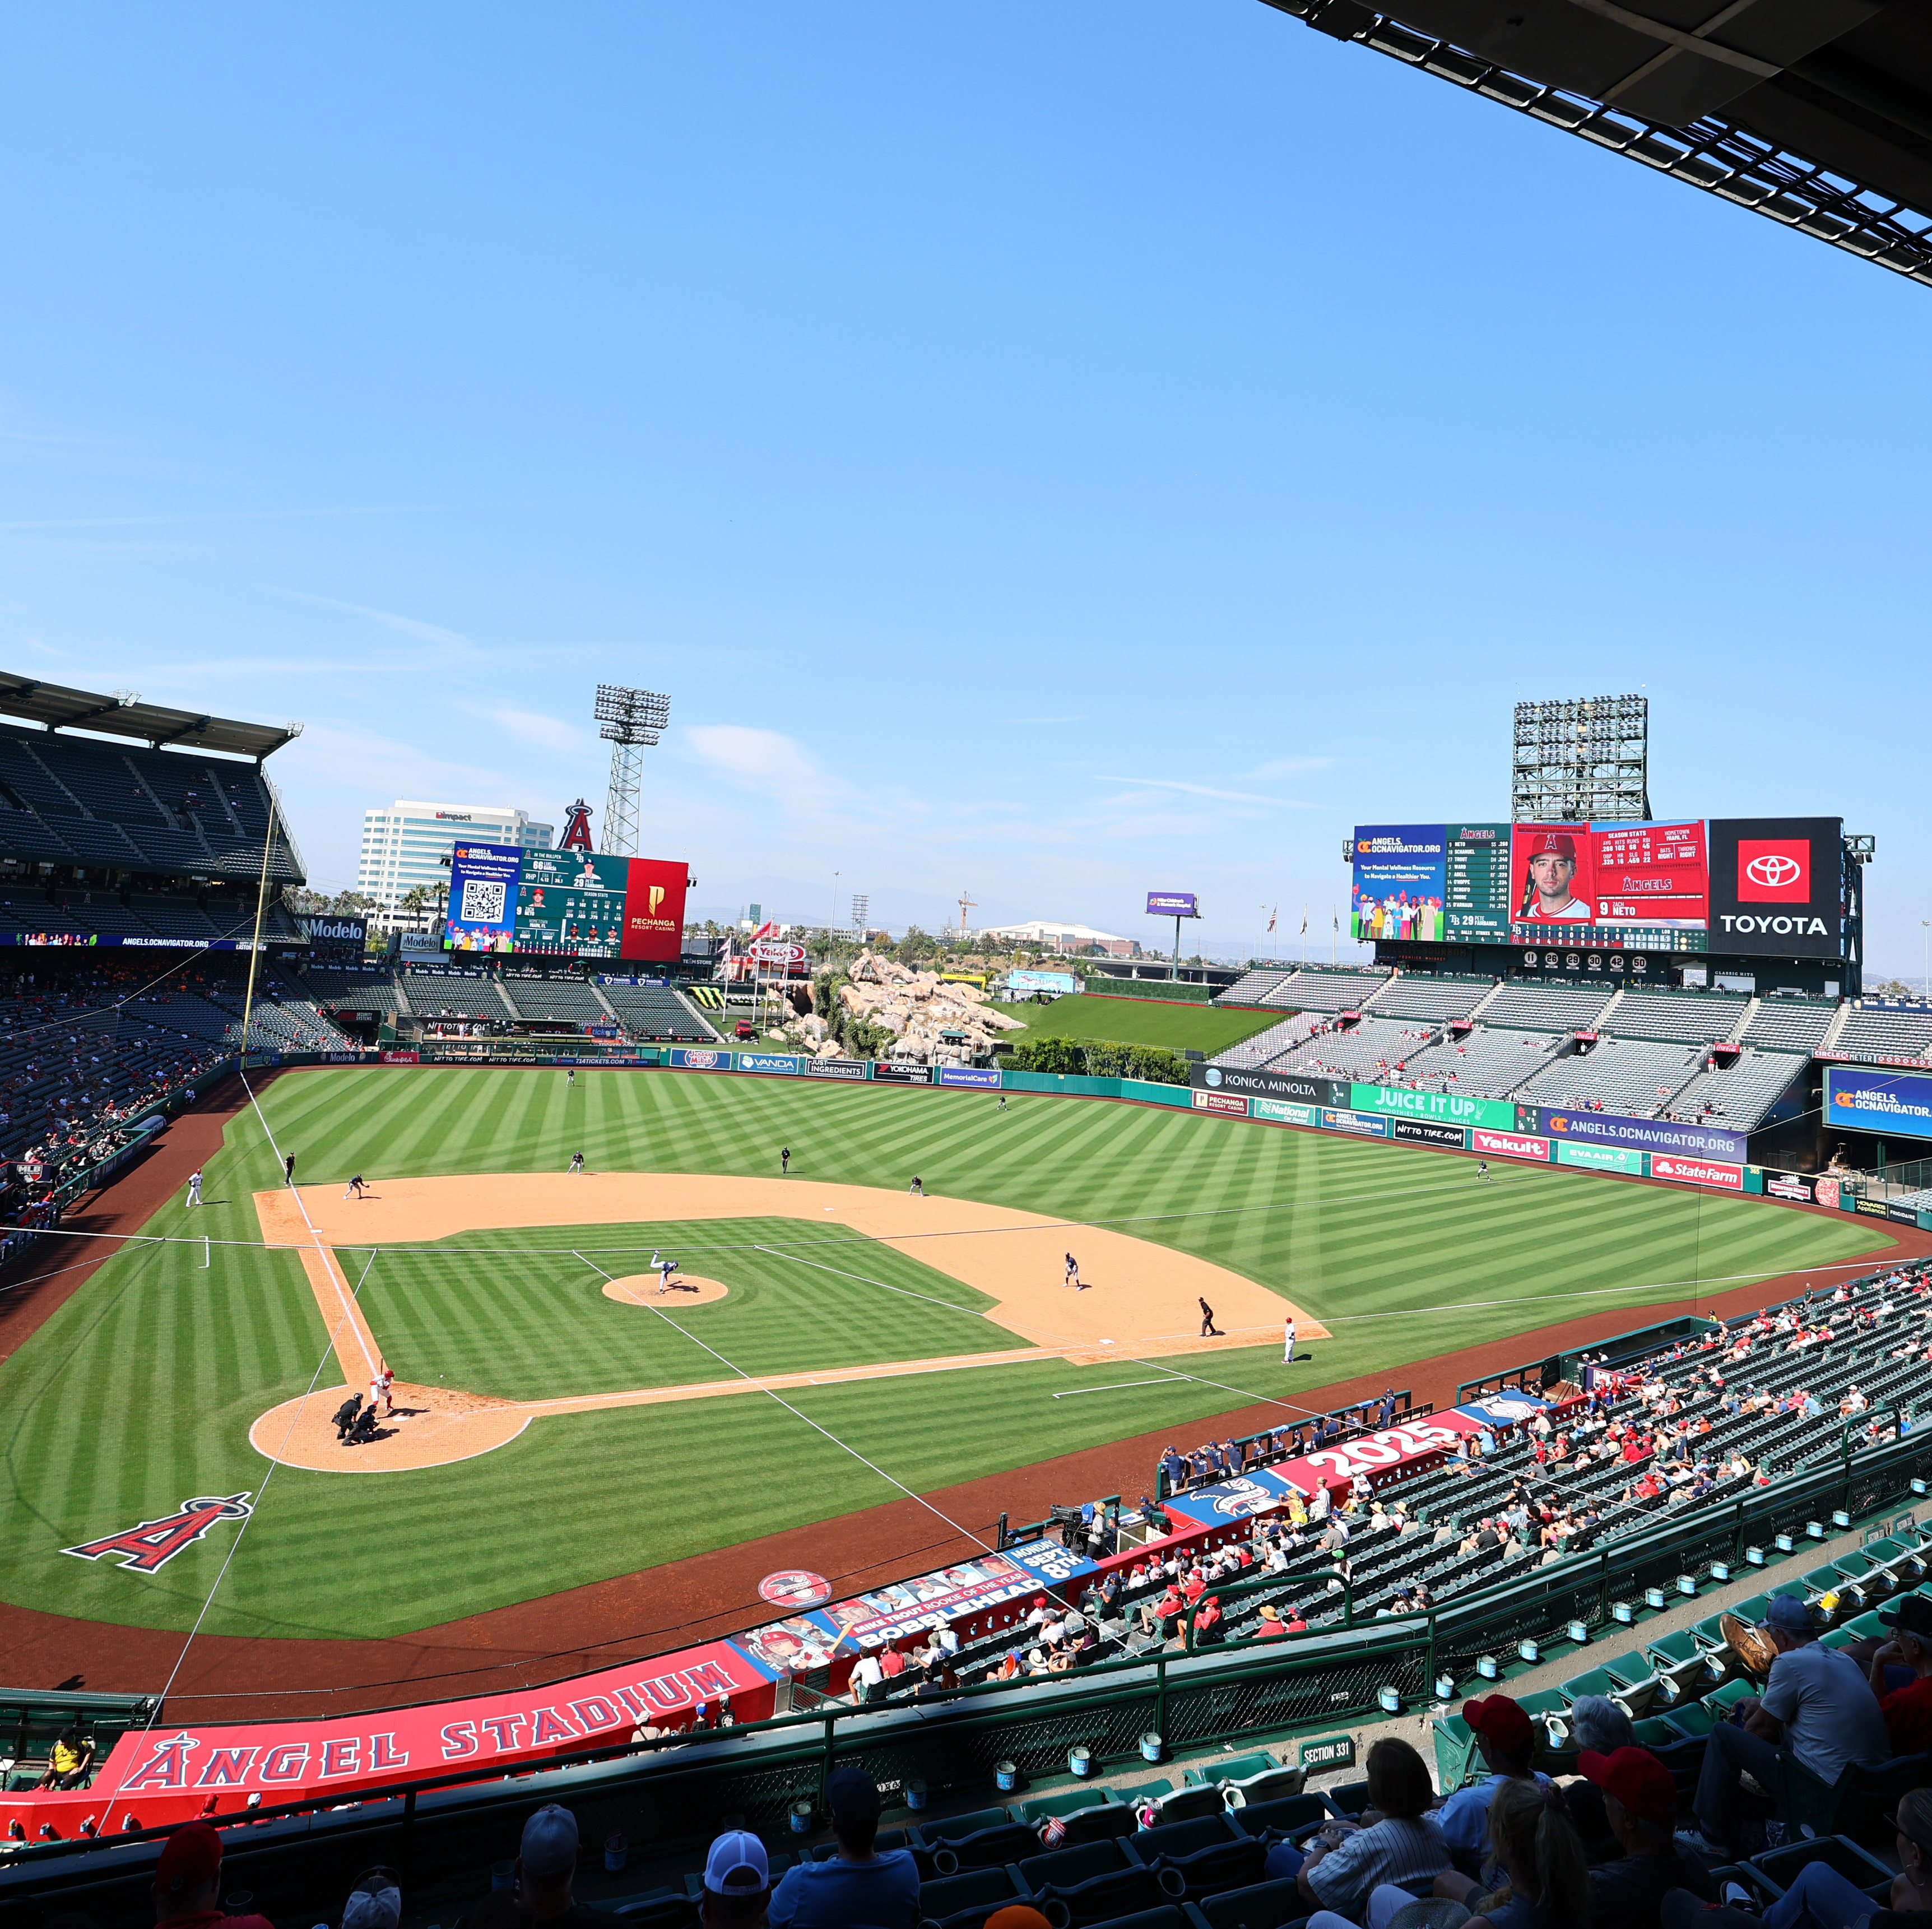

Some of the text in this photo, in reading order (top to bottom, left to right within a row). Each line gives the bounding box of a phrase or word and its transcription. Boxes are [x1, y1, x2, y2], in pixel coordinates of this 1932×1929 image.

[443, 811, 472, 822] impact
[1460, 827, 1495, 839] ANGELS
[1372, 845, 1441, 853] OCNAVIGATOR.ORG
[468, 853, 519, 863] OCNAVIGATOR.ORG
[533, 861, 544, 870] 66
[574, 878, 584, 887] 29
[1622, 876, 1673, 891] ANGELS
[517, 906, 522, 915] 9
[1599, 901, 1609, 915] 9
[1613, 907, 1636, 916] NETO
[631, 918, 675, 927] PECHANGA
[1462, 915, 1474, 925] 29
[1720, 915, 1828, 935] TOYOTA
[309, 919, 363, 939] Modelo
[123, 938, 209, 948] ANGELS.OCNAVIGATOR.ORG
[407, 935, 436, 948] Modelo
[329, 1054, 355, 1062] Modelo
[754, 1058, 795, 1068] VANDA
[1850, 1054, 1873, 1062] METER
[811, 1065, 861, 1075] INGREDIENTS
[890, 1065, 928, 1074] YOKOHAMA
[944, 1073, 988, 1082] MemorialCare
[1225, 1074, 1316, 1096] KONICA MINOLTA
[1209, 1097, 1244, 1107] PECHANGA
[1374, 1087, 1425, 1111] JUICE
[1431, 1095, 1447, 1114] IT
[1855, 1090, 1899, 1103] ANGELS.
[1271, 1102, 1310, 1119] National
[1378, 1107, 1414, 1117] SMOOTHIES
[1855, 1100, 1932, 1118] OCNAVIGATOR.
[1336, 1118, 1383, 1130] OCNAVIGATOR.ORG
[1397, 1124, 1462, 1142] NITTO TIRE.COM
[1571, 1120, 1735, 1152] ANGELS.OCNAVIGATOR.ORG
[1478, 1135, 1544, 1156] Yakult
[1569, 1149, 1614, 1161] EVA AIR
[1771, 1184, 1808, 1195] MOUNTAIN MIKE'S
[1856, 1204, 1886, 1216] Appliances
[1857, 1199, 1886, 1210] HOWARDS
[1890, 1209, 1915, 1221] FRIGIDAIRE
[1307, 1421, 1457, 1478] 2025
[1223, 1490, 1261, 1506] AMERICAN
[1010, 1540, 1057, 1559] MONDAY
[1023, 1547, 1072, 1568] SEPT.
[1041, 1554, 1085, 1580] 8TH
[853, 1572, 1025, 1635] MIKE TROUT ROOKIE OF THE YEAR
[854, 1579, 1045, 1648] BOBBLEHEAD
[115, 1660, 741, 1792] ANGEL STADIUM
[1304, 1741, 1349, 1763] SECTION 331
